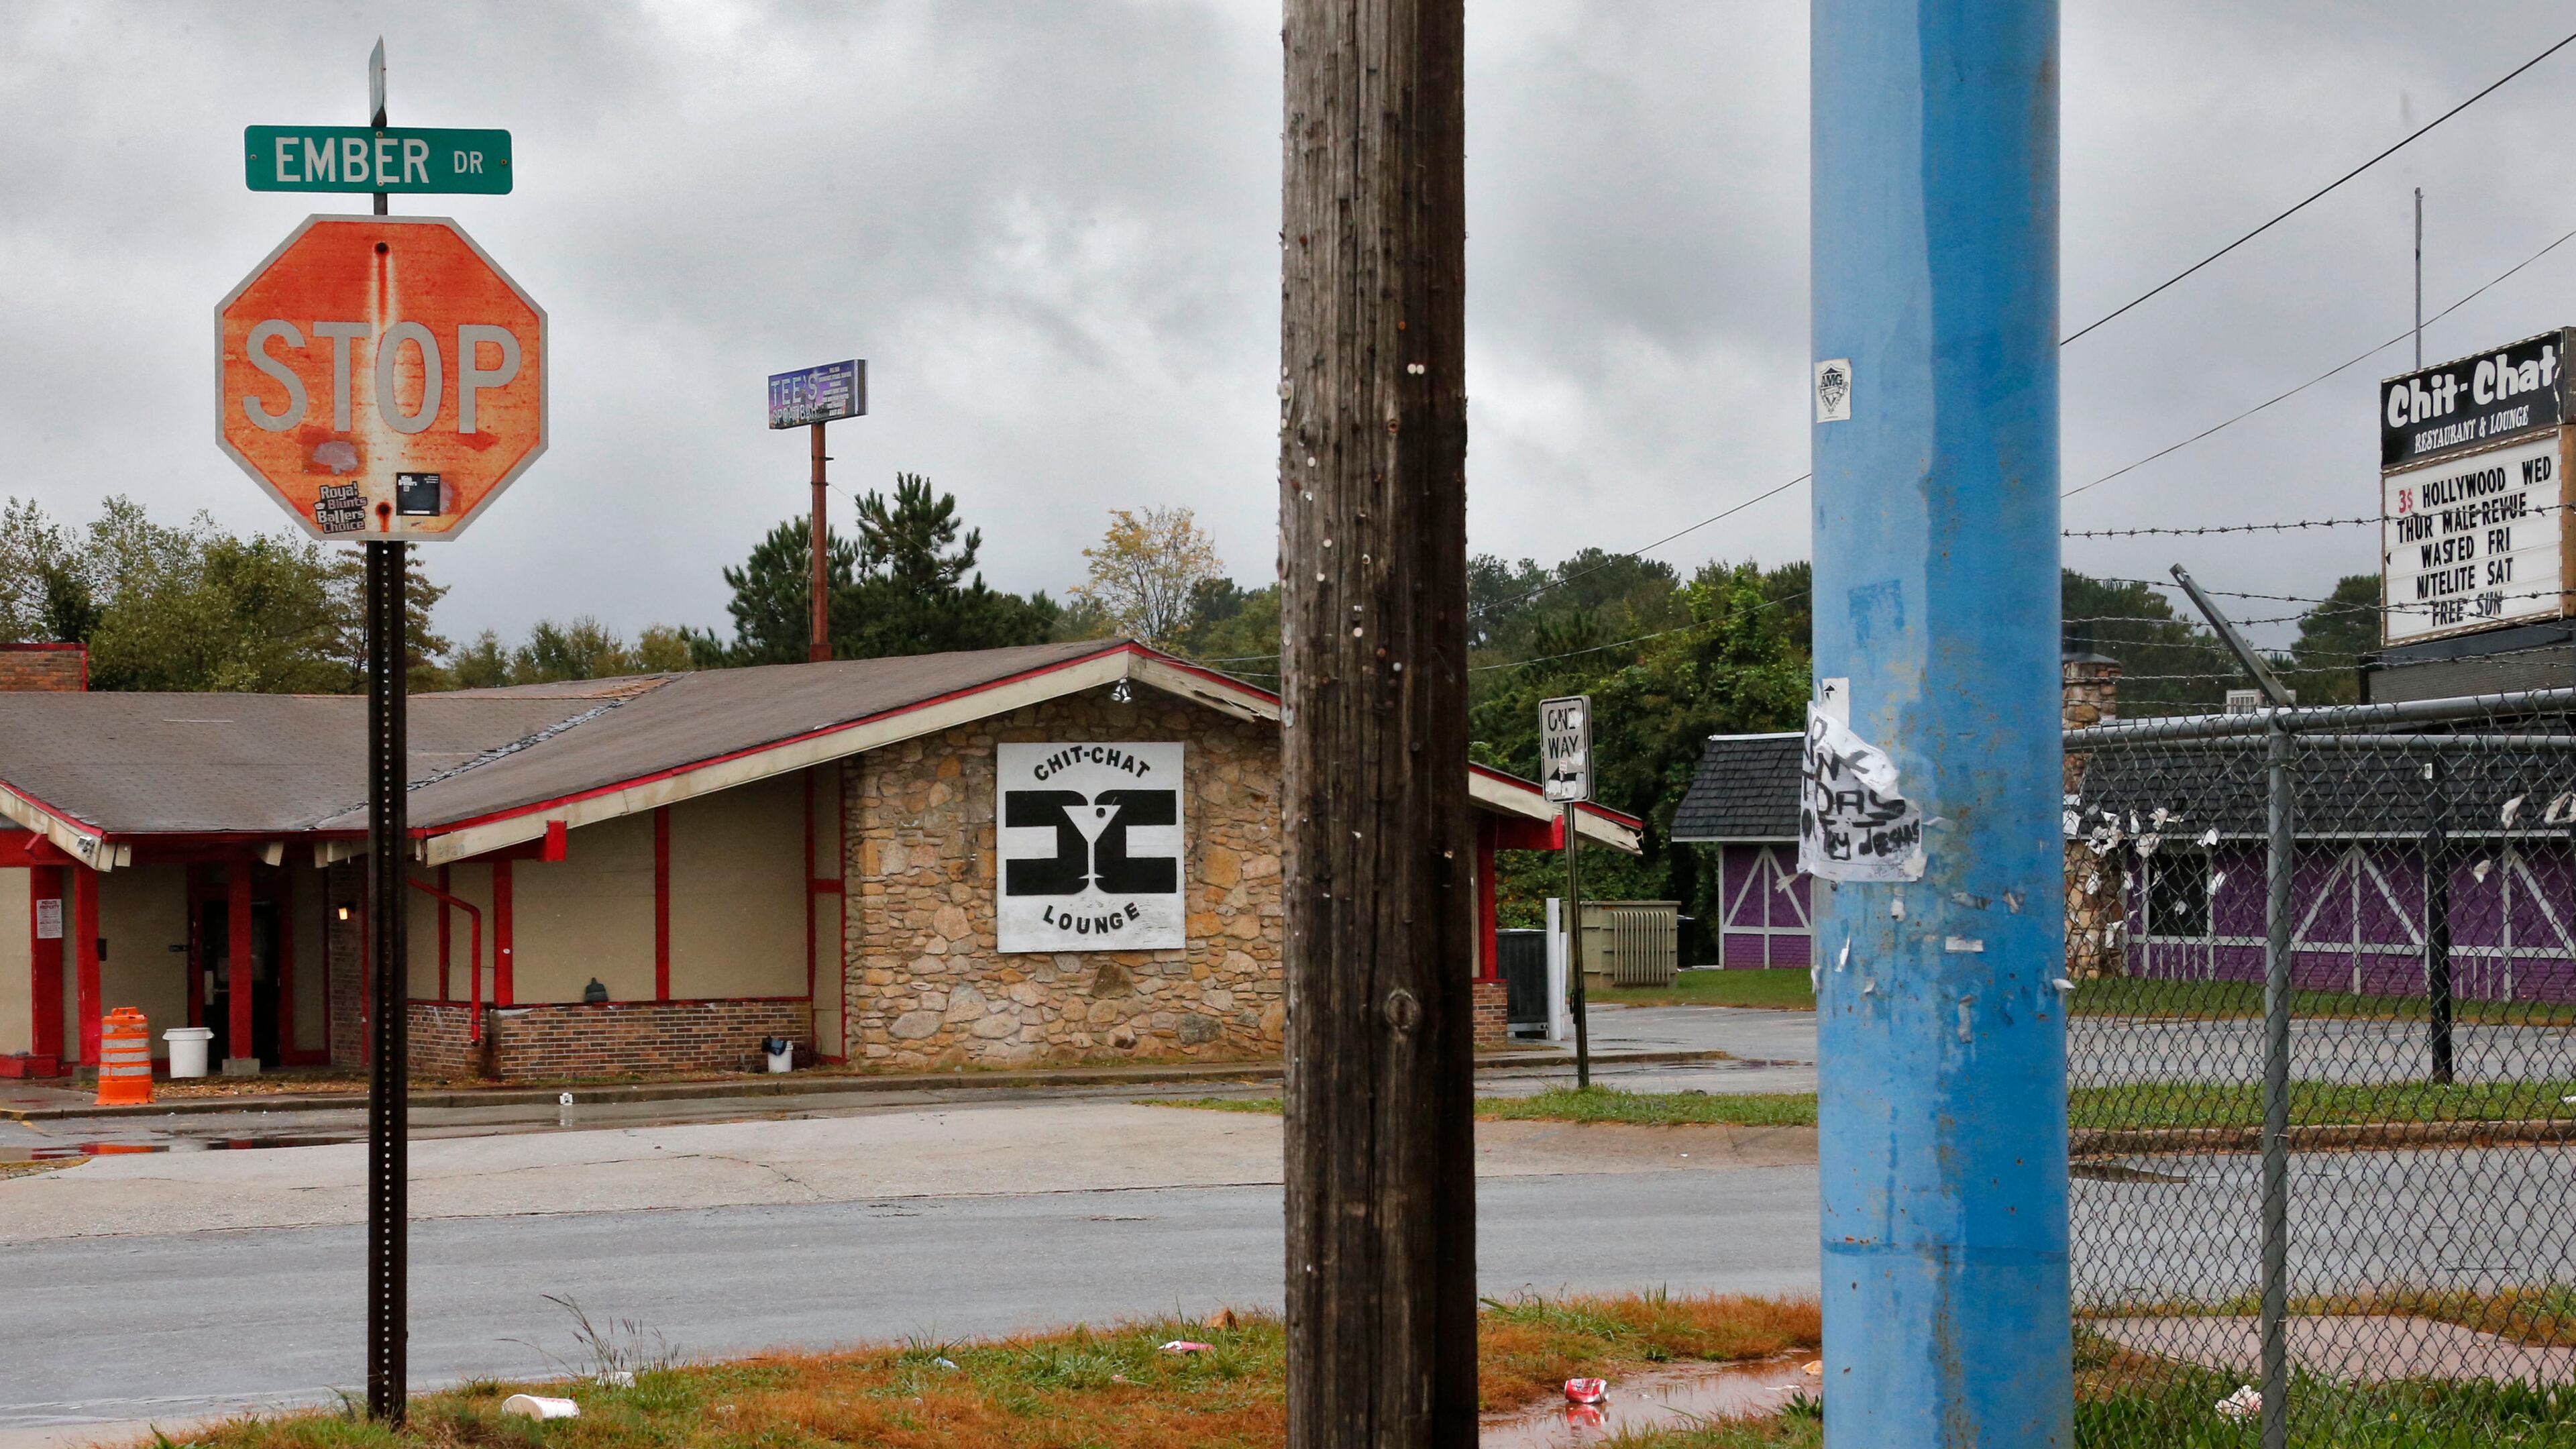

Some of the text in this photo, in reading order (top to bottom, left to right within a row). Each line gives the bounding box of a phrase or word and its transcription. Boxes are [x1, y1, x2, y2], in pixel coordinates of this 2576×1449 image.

[275, 137, 484, 183] EMBER DR
[242, 319, 522, 435] STOP
[771, 374, 818, 407] TEE'S
[2387, 345, 2557, 428] Chit-Chat
[2414, 405, 2530, 454] RESTAURANT & LOUNGE
[2398, 455, 2552, 514] 3$ HOLLYWOOD WED
[317, 509, 365, 524] Ballers
[323, 521, 365, 533] Choice
[2397, 492, 2527, 543] THUR MALE REVUE
[2421, 527, 2510, 569] WASTED FRI
[2487, 557, 2514, 586] SAT
[2432, 590, 2504, 627] FREE SUN
[1033, 745, 1150, 782] CHIT-CHAT
[1548, 735, 1578, 759] WAY
[1042, 902, 1140, 934] LOUNGE
